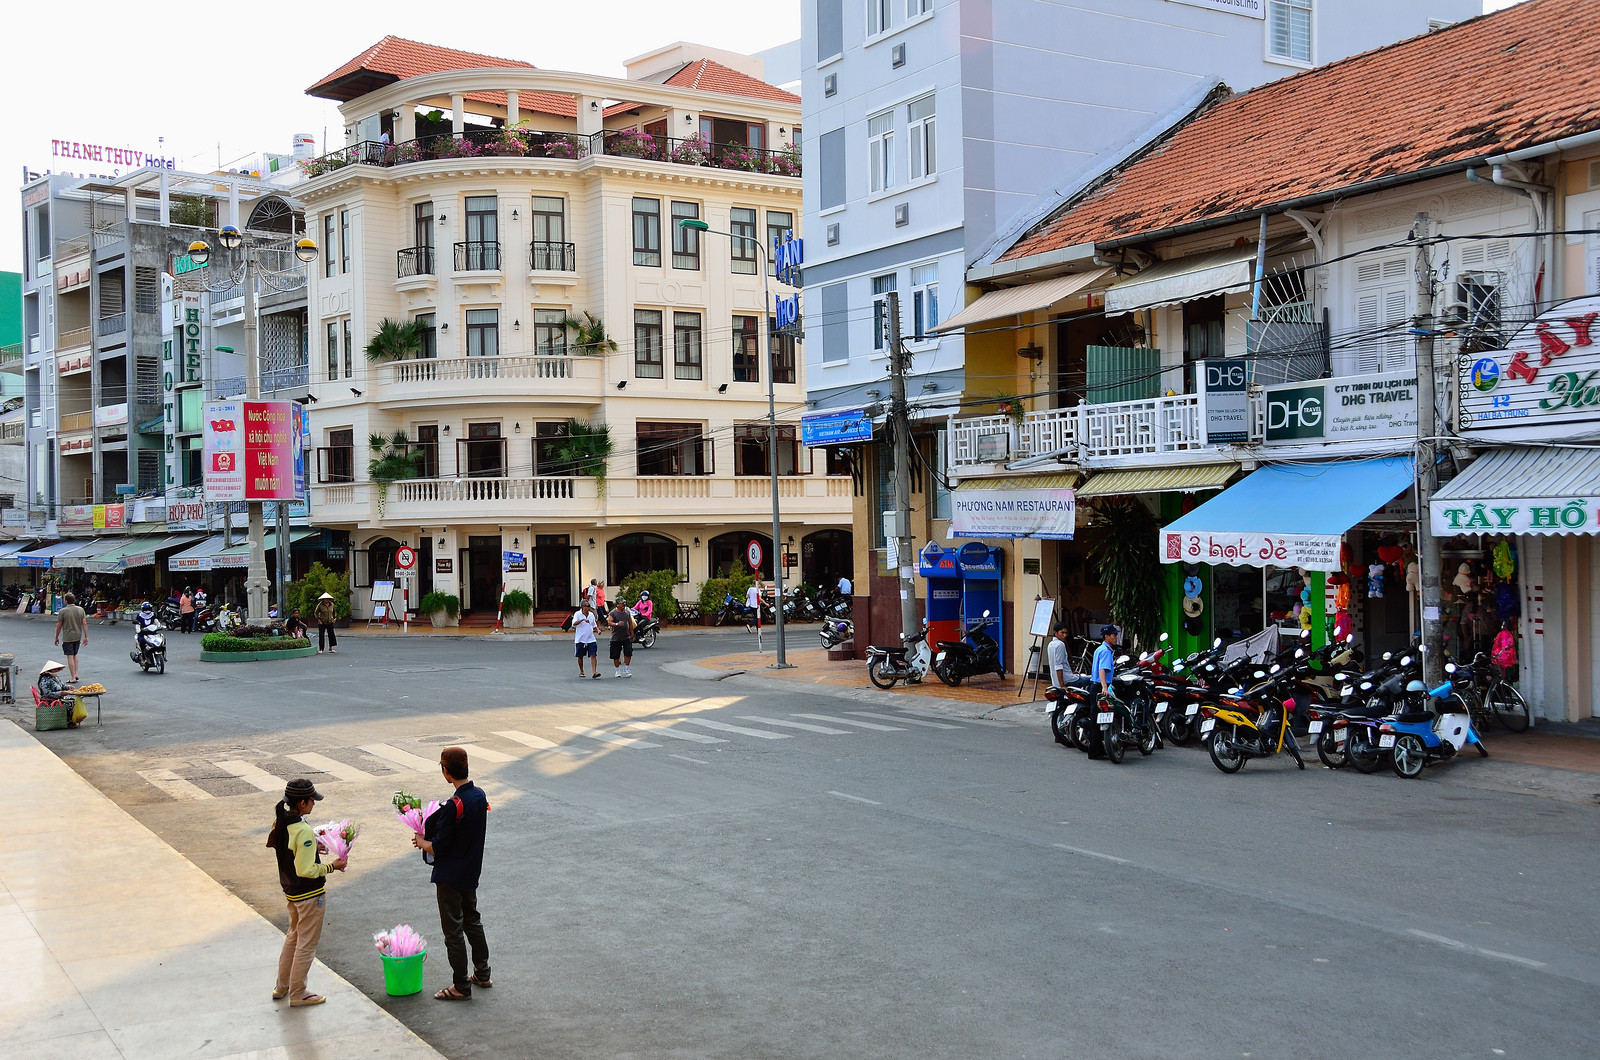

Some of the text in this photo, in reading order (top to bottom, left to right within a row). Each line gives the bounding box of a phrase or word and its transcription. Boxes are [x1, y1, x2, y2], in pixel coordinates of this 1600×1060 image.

[51, 139, 103, 162] THANH
[145, 153, 176, 171] Hotel
[186, 308, 200, 382] HOTEL
[1207, 365, 1244, 386] DHG
[1334, 384, 1350, 393] CTY
[1351, 383, 1371, 392] TNHH
[1372, 382, 1384, 390] DU
[1341, 390, 1414, 406] DHG TRAVEL
[1268, 397, 1322, 430] DHG
[1478, 412, 1490, 420] HAI
[957, 500, 1074, 512] PHƯƠNG NAM RESTAURANT
[1444, 503, 1518, 529] TÂY
[1188, 536, 1201, 557] 3
